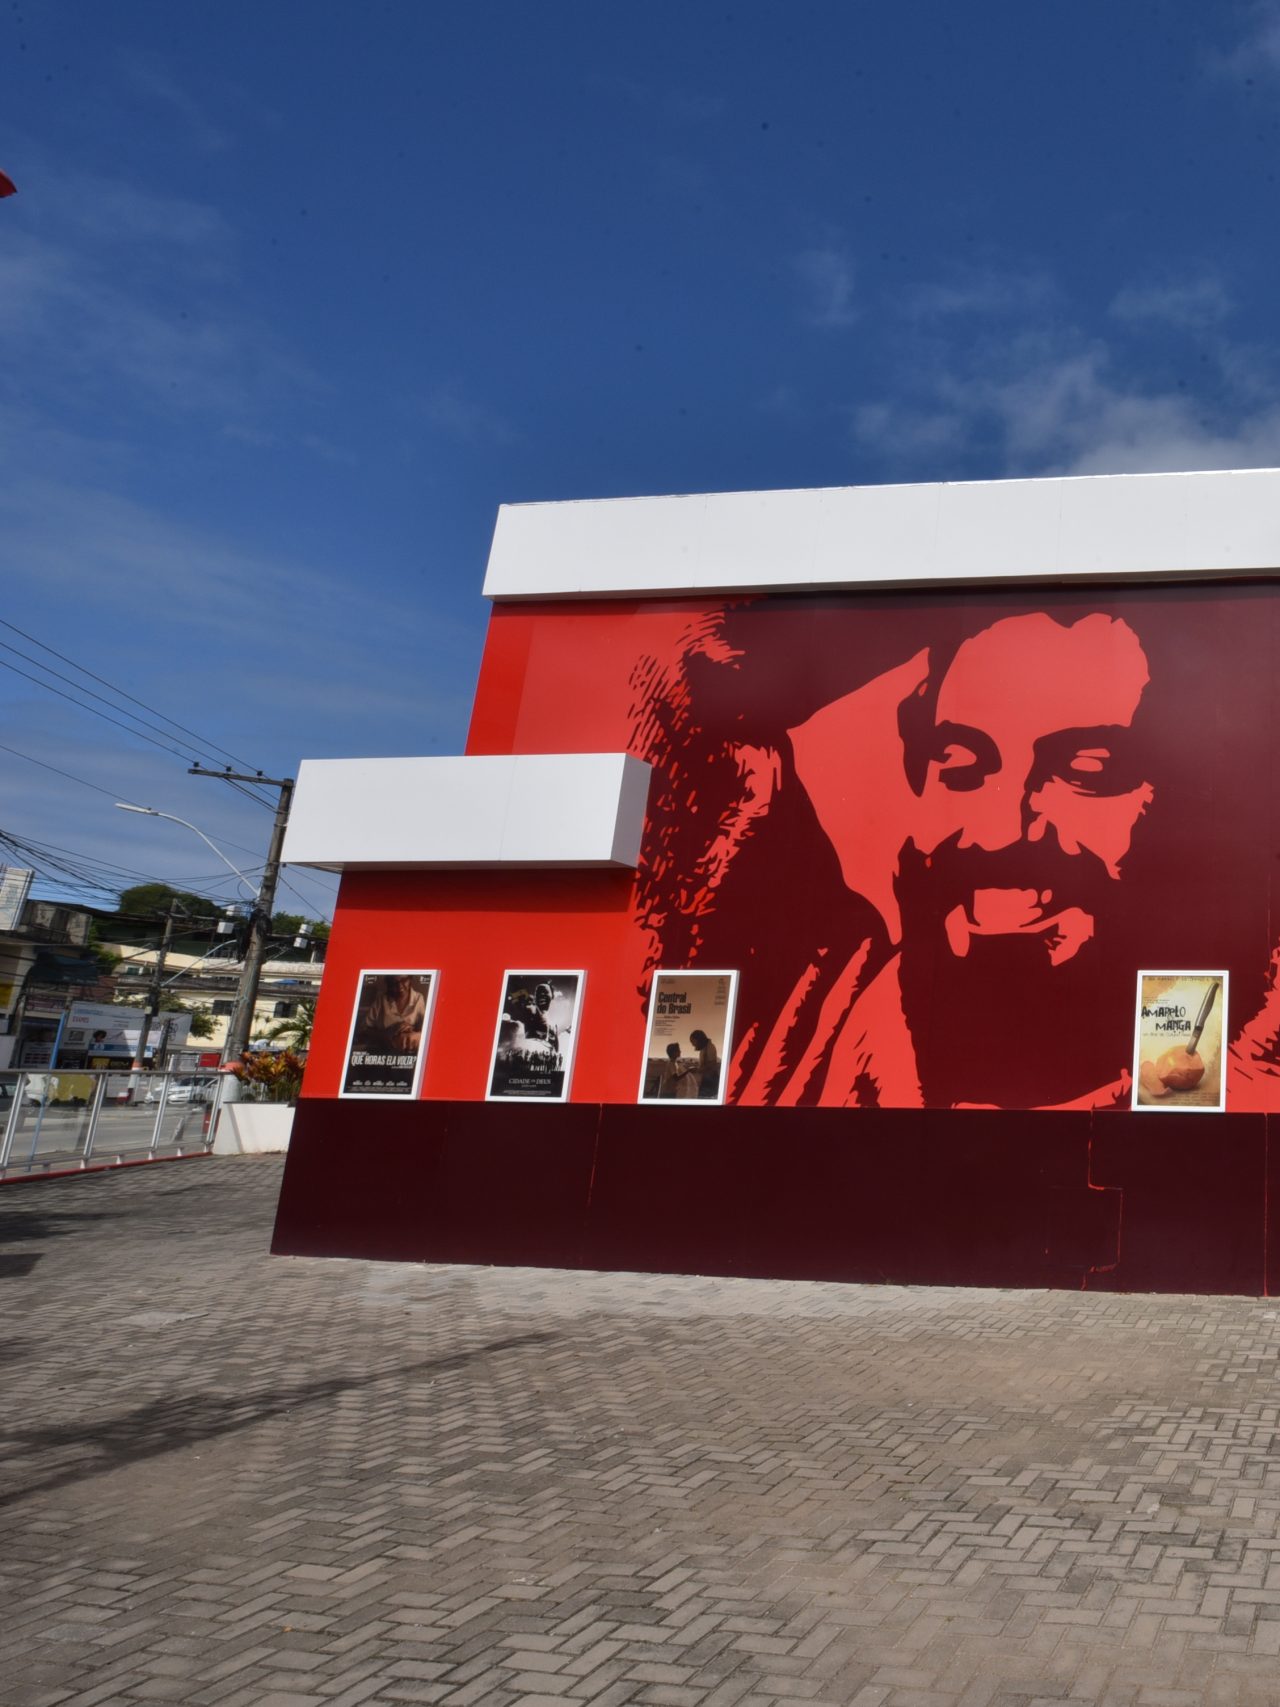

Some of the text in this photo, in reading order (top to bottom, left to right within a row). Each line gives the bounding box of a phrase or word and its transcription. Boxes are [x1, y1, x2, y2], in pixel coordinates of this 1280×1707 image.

[658, 992, 687, 1003] Central
[656, 1003, 691, 1014] do Brasil
[1155, 1020, 1191, 1031] MANGA
[351, 1055, 364, 1066] QUE
[364, 1055, 386, 1065] HORAS
[386, 1055, 397, 1066] ELA
